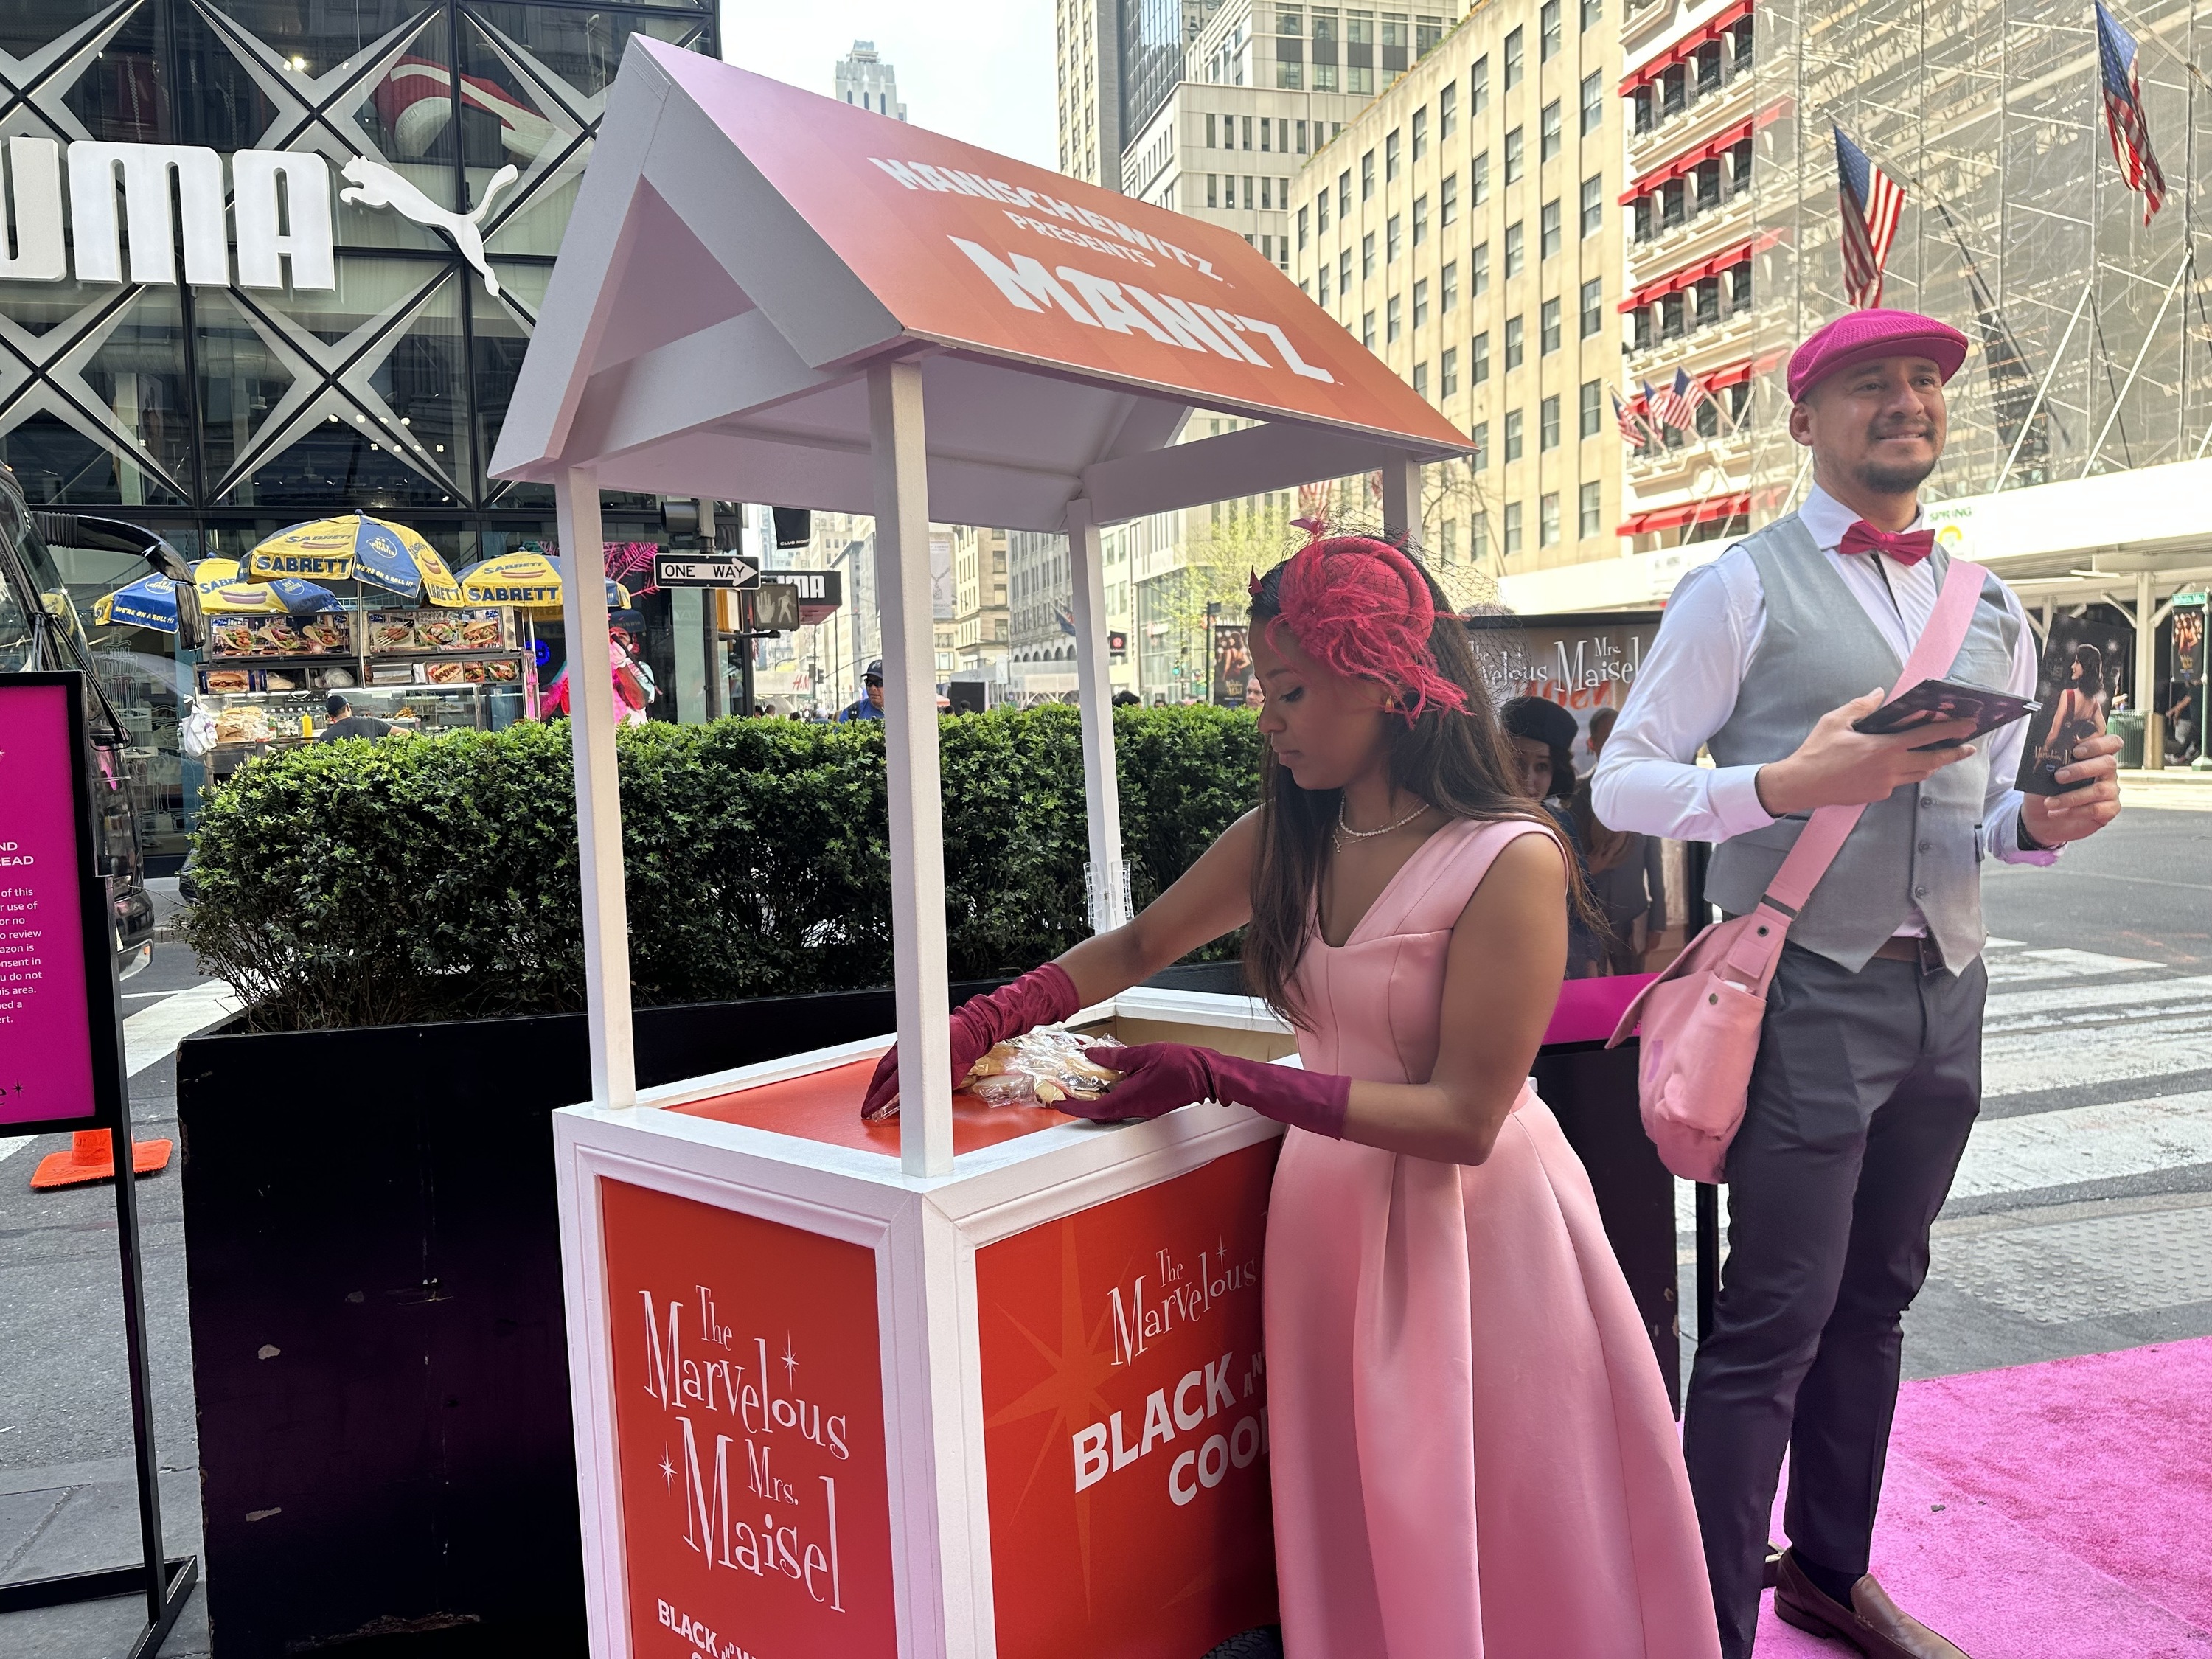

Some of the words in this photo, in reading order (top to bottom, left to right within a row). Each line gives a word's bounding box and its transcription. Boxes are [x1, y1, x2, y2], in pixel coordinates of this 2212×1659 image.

[867, 156, 1224, 282] MANISCHEWITZ
[1001, 209, 1156, 268] PRESENTS
[255, 555, 350, 574] SABRETT
[484, 562, 543, 574] SABRETT
[665, 565, 695, 577] ONE
[713, 566, 745, 578] WAY
[355, 563, 375, 575] WE'RE
[390, 576, 405, 585] ROLL
[199, 578, 237, 594] SABR
[468, 586, 559, 602] SABRETT
[778, 575, 826, 598] MA
[115, 606, 136, 616] WE'RE
[136, 611, 146, 619] ON
[151, 614, 167, 622] ROLL
[1554, 636, 1639, 695] Maisel
[0, 855, 34, 866] EAD
[1, 888, 13, 897] of
[15, 888, 34, 897] this
[7, 903, 24, 911] use
[27, 901, 38, 910] of
[13, 917, 25, 925] no
[9, 929, 42, 939] review
[27, 943, 35, 952] is
[0, 958, 29, 967] nsent
[32, 956, 41, 966] in
[9, 972, 23, 981] do
[25, 970, 43, 980] not
[0, 987, 10, 996] is
[13, 987, 37, 995] area.
[0, 1000, 14, 1010] ed
[0, 1015, 13, 1024] rt.
[1155, 1248, 1184, 1288] The
[1107, 1251, 1256, 1367] Marvelous
[695, 1284, 733, 1352] The
[639, 1290, 850, 1460] Marvelous
[1071, 1351, 1237, 1494] BLACK
[1243, 1349, 1266, 1399] AN
[745, 1439, 799, 1506] Mrs.
[675, 1416, 846, 1613] Maisel
[658, 1597, 719, 1659] BLACK
